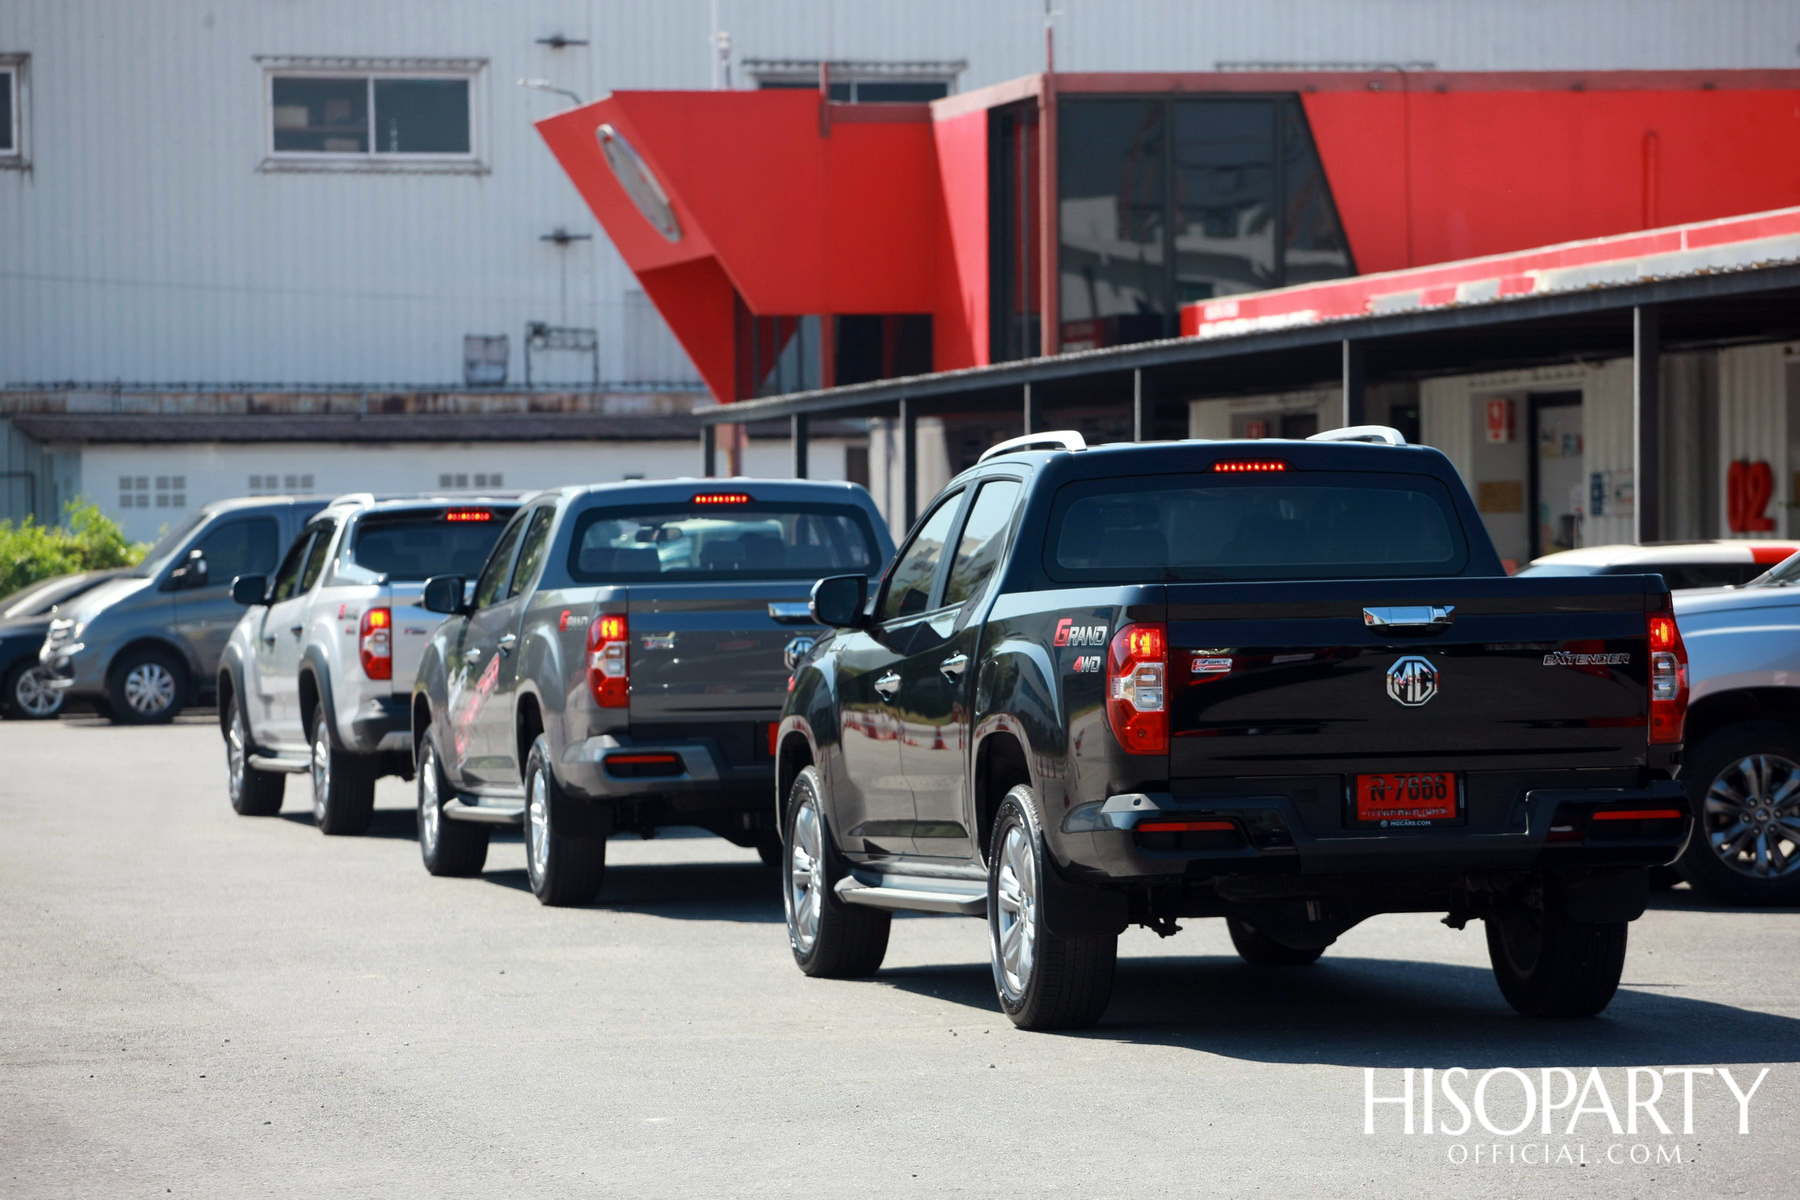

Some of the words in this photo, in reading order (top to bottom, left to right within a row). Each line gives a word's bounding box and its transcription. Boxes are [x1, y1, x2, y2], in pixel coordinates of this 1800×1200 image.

[1727, 461, 1774, 532] 02
[1054, 618, 1107, 646] GRAND
[1073, 656, 1101, 672] 4WD
[1543, 651, 1630, 665] EXTENDER
[1390, 660, 1436, 703] MG
